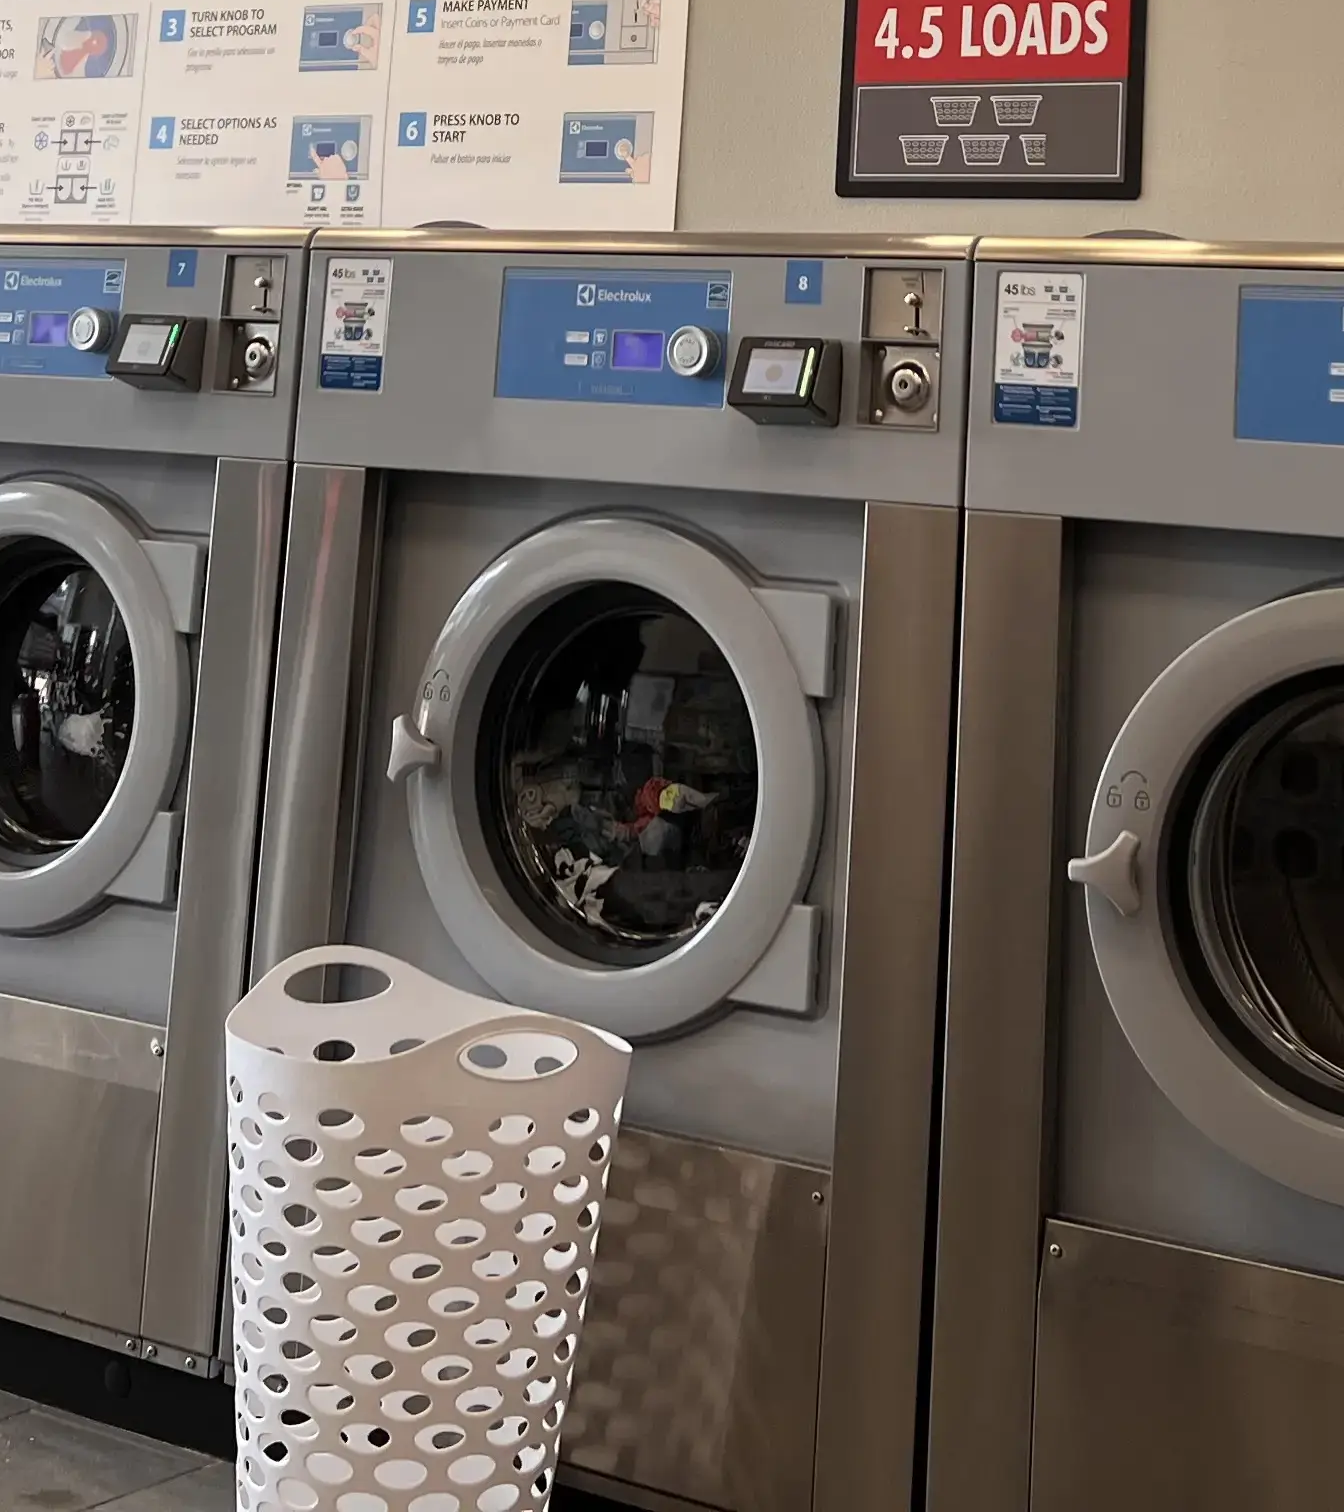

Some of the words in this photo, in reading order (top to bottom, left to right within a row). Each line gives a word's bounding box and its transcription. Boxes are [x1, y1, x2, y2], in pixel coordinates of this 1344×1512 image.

[443, 0, 474, 13] MAKE
[192, 11, 218, 22] TURN
[220, 10, 248, 21] KNOB
[251, 9, 264, 20] TO
[415, 8, 427, 27] 5
[441, 17, 463, 29] Insert
[465, 16, 487, 29] Coins
[490, 19, 499, 28] or
[501, 16, 538, 30] Payment
[540, 14, 560, 26] Card
[167, 18, 177, 36] 3
[190, 26, 224, 38] SELECT
[226, 24, 277, 36] PROGRAM
[874, 6, 944, 59] 4.5
[960, 0, 1108, 57] LOADS
[181, 118, 215, 130] SELECT
[217, 117, 261, 129] OPTIONS
[263, 117, 277, 128] AS
[433, 114, 466, 127] PRESS
[469, 114, 501, 126] KNOB
[504, 113, 519, 125] TO
[156, 125, 167, 143] 4
[406, 121, 419, 141] 6
[432, 131, 466, 143] START
[179, 134, 218, 145] NEEDED
[177, 262, 187, 276] 7
[332, 268, 344, 279] 45
[20, 274, 62, 287] Electrolux
[798, 276, 809, 290] 8
[598, 289, 652, 303] Electrolux
[1003, 284, 1019, 295] 45
